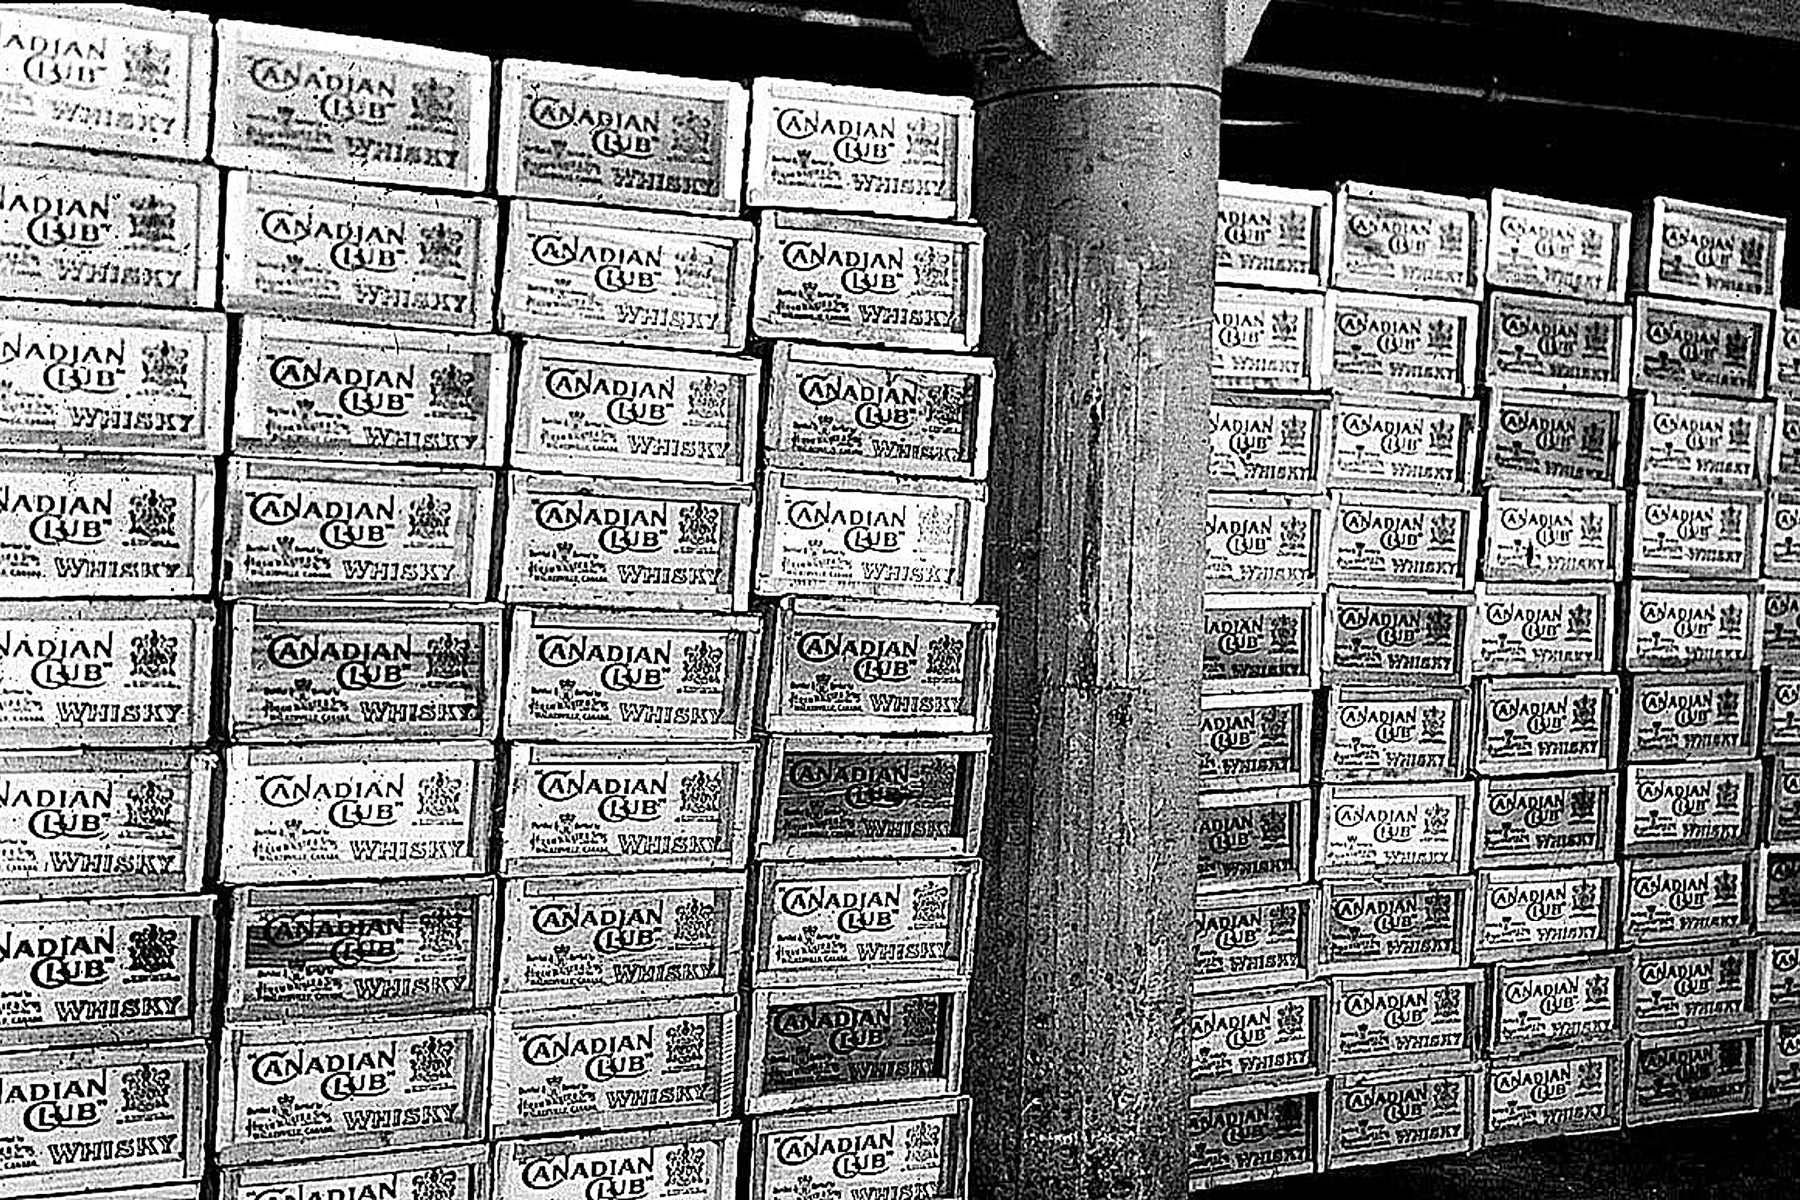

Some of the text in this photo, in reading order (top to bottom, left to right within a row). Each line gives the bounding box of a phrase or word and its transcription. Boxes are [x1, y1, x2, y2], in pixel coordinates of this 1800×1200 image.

[617, 563, 723, 586] WHISKY
[57, 701, 183, 724] WHISKY
[619, 702, 725, 725] WHISKY
[350, 839, 465, 860] WHISKY
[618, 834, 722, 856] WHISKY
[613, 962, 716, 984] WHISKY
[55, 996, 182, 1021] WHISKY
[605, 1085, 709, 1109] WHISKY
[343, 1103, 459, 1131] WHISKY
[48, 1134, 177, 1164] WHISKY
